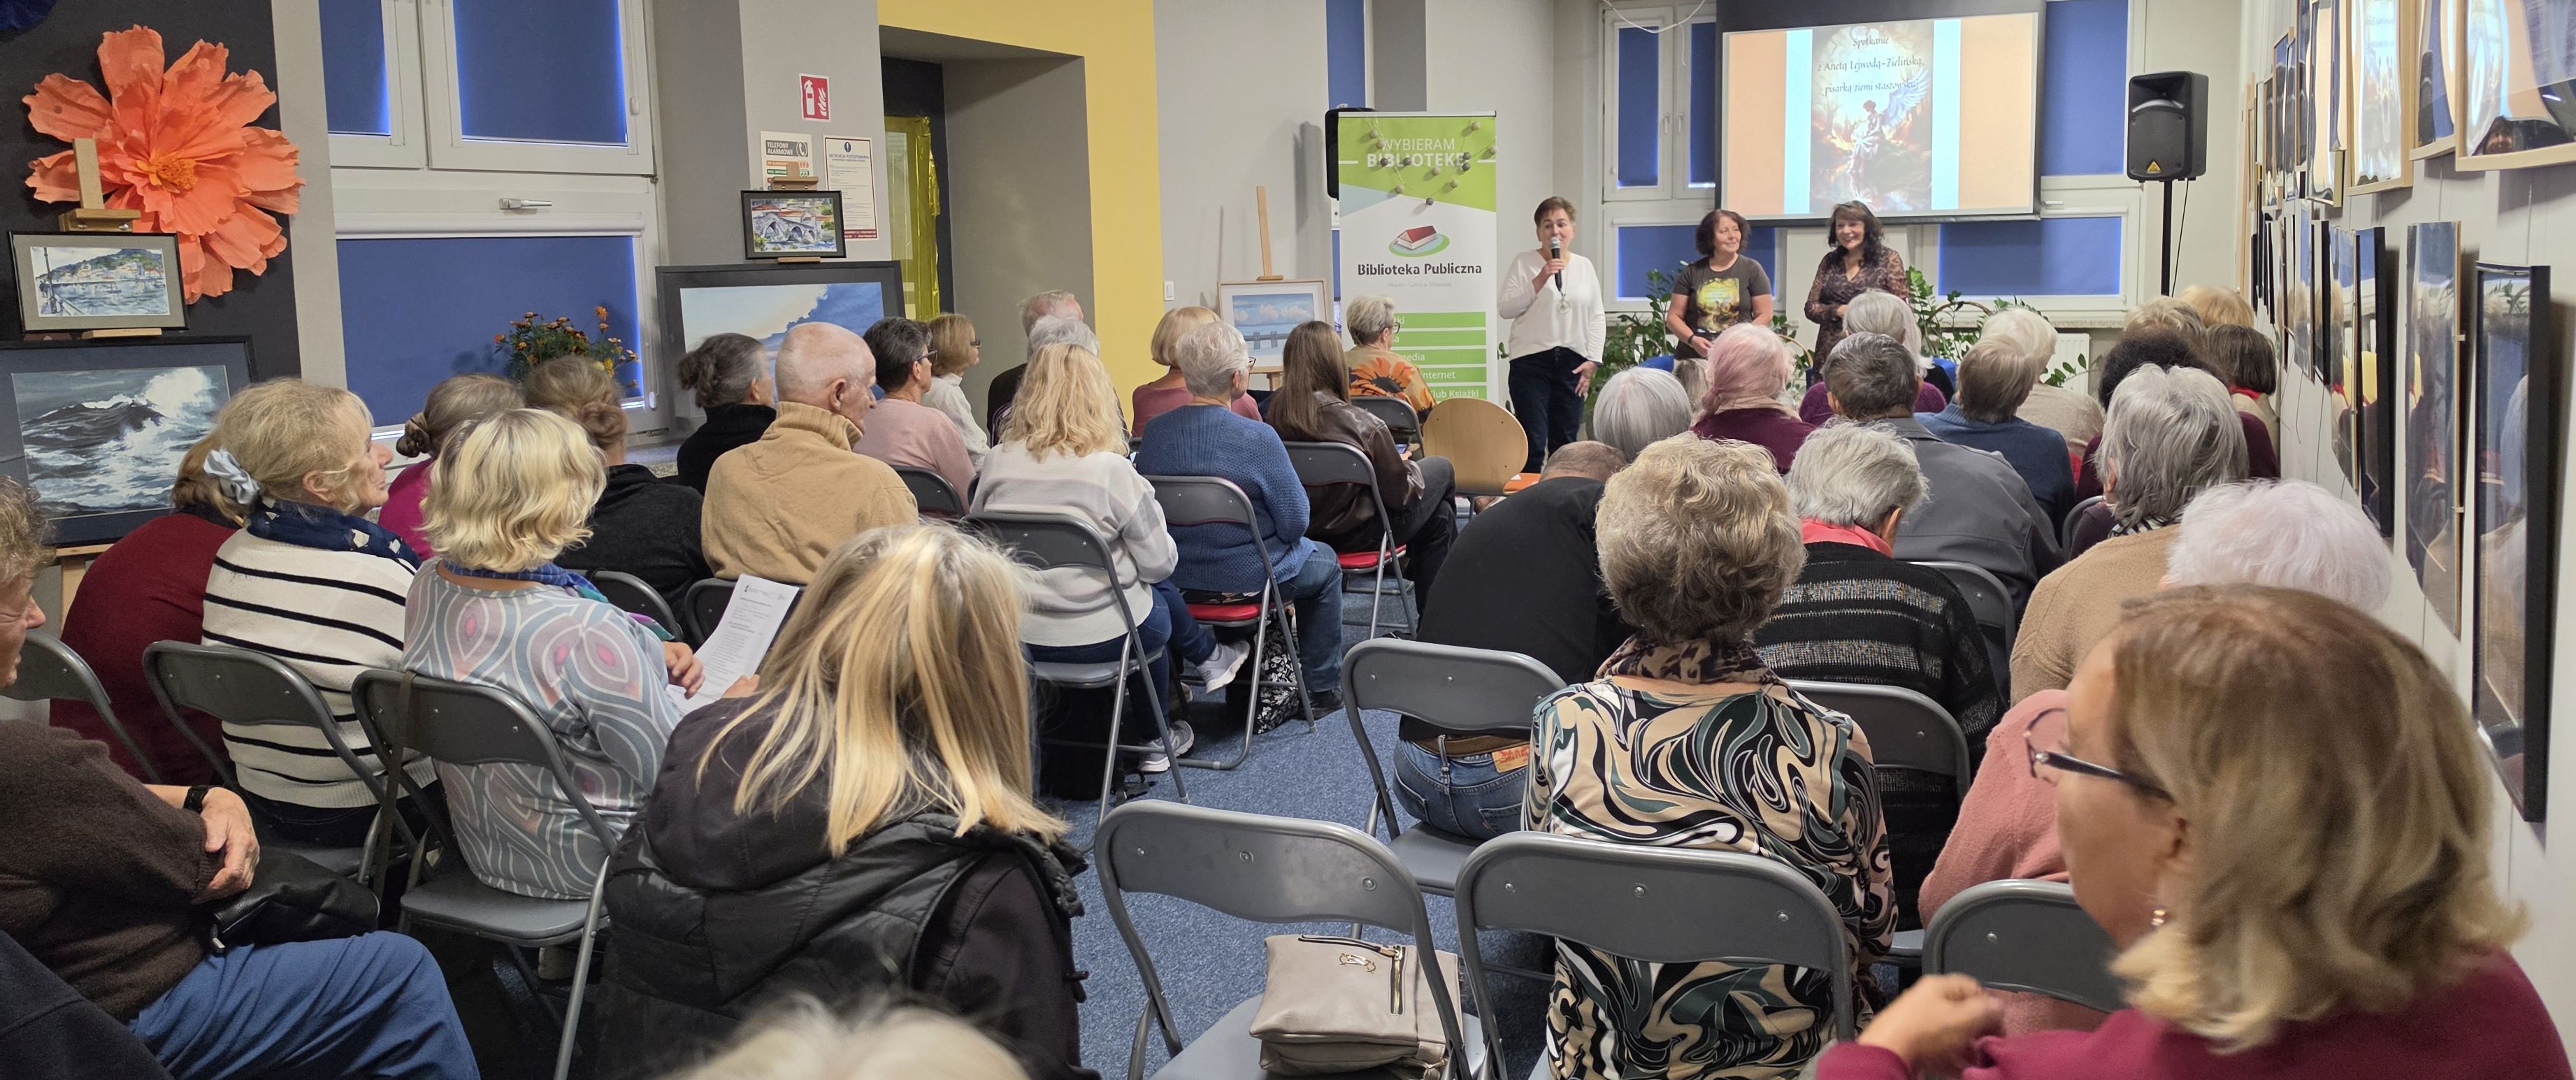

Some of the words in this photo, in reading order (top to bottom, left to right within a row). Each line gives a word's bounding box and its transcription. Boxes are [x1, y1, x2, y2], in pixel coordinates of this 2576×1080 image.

[1852, 35, 1890, 49] Spotkanie
[1825, 62, 1847, 72] Anetą
[1825, 82, 1852, 96] pisarką
[1854, 81, 1873, 92] ziemi
[1382, 138, 1455, 151] WYBIERAM
[1358, 263, 1420, 275] Biblioteka
[1424, 262, 1482, 275] Publiczna
